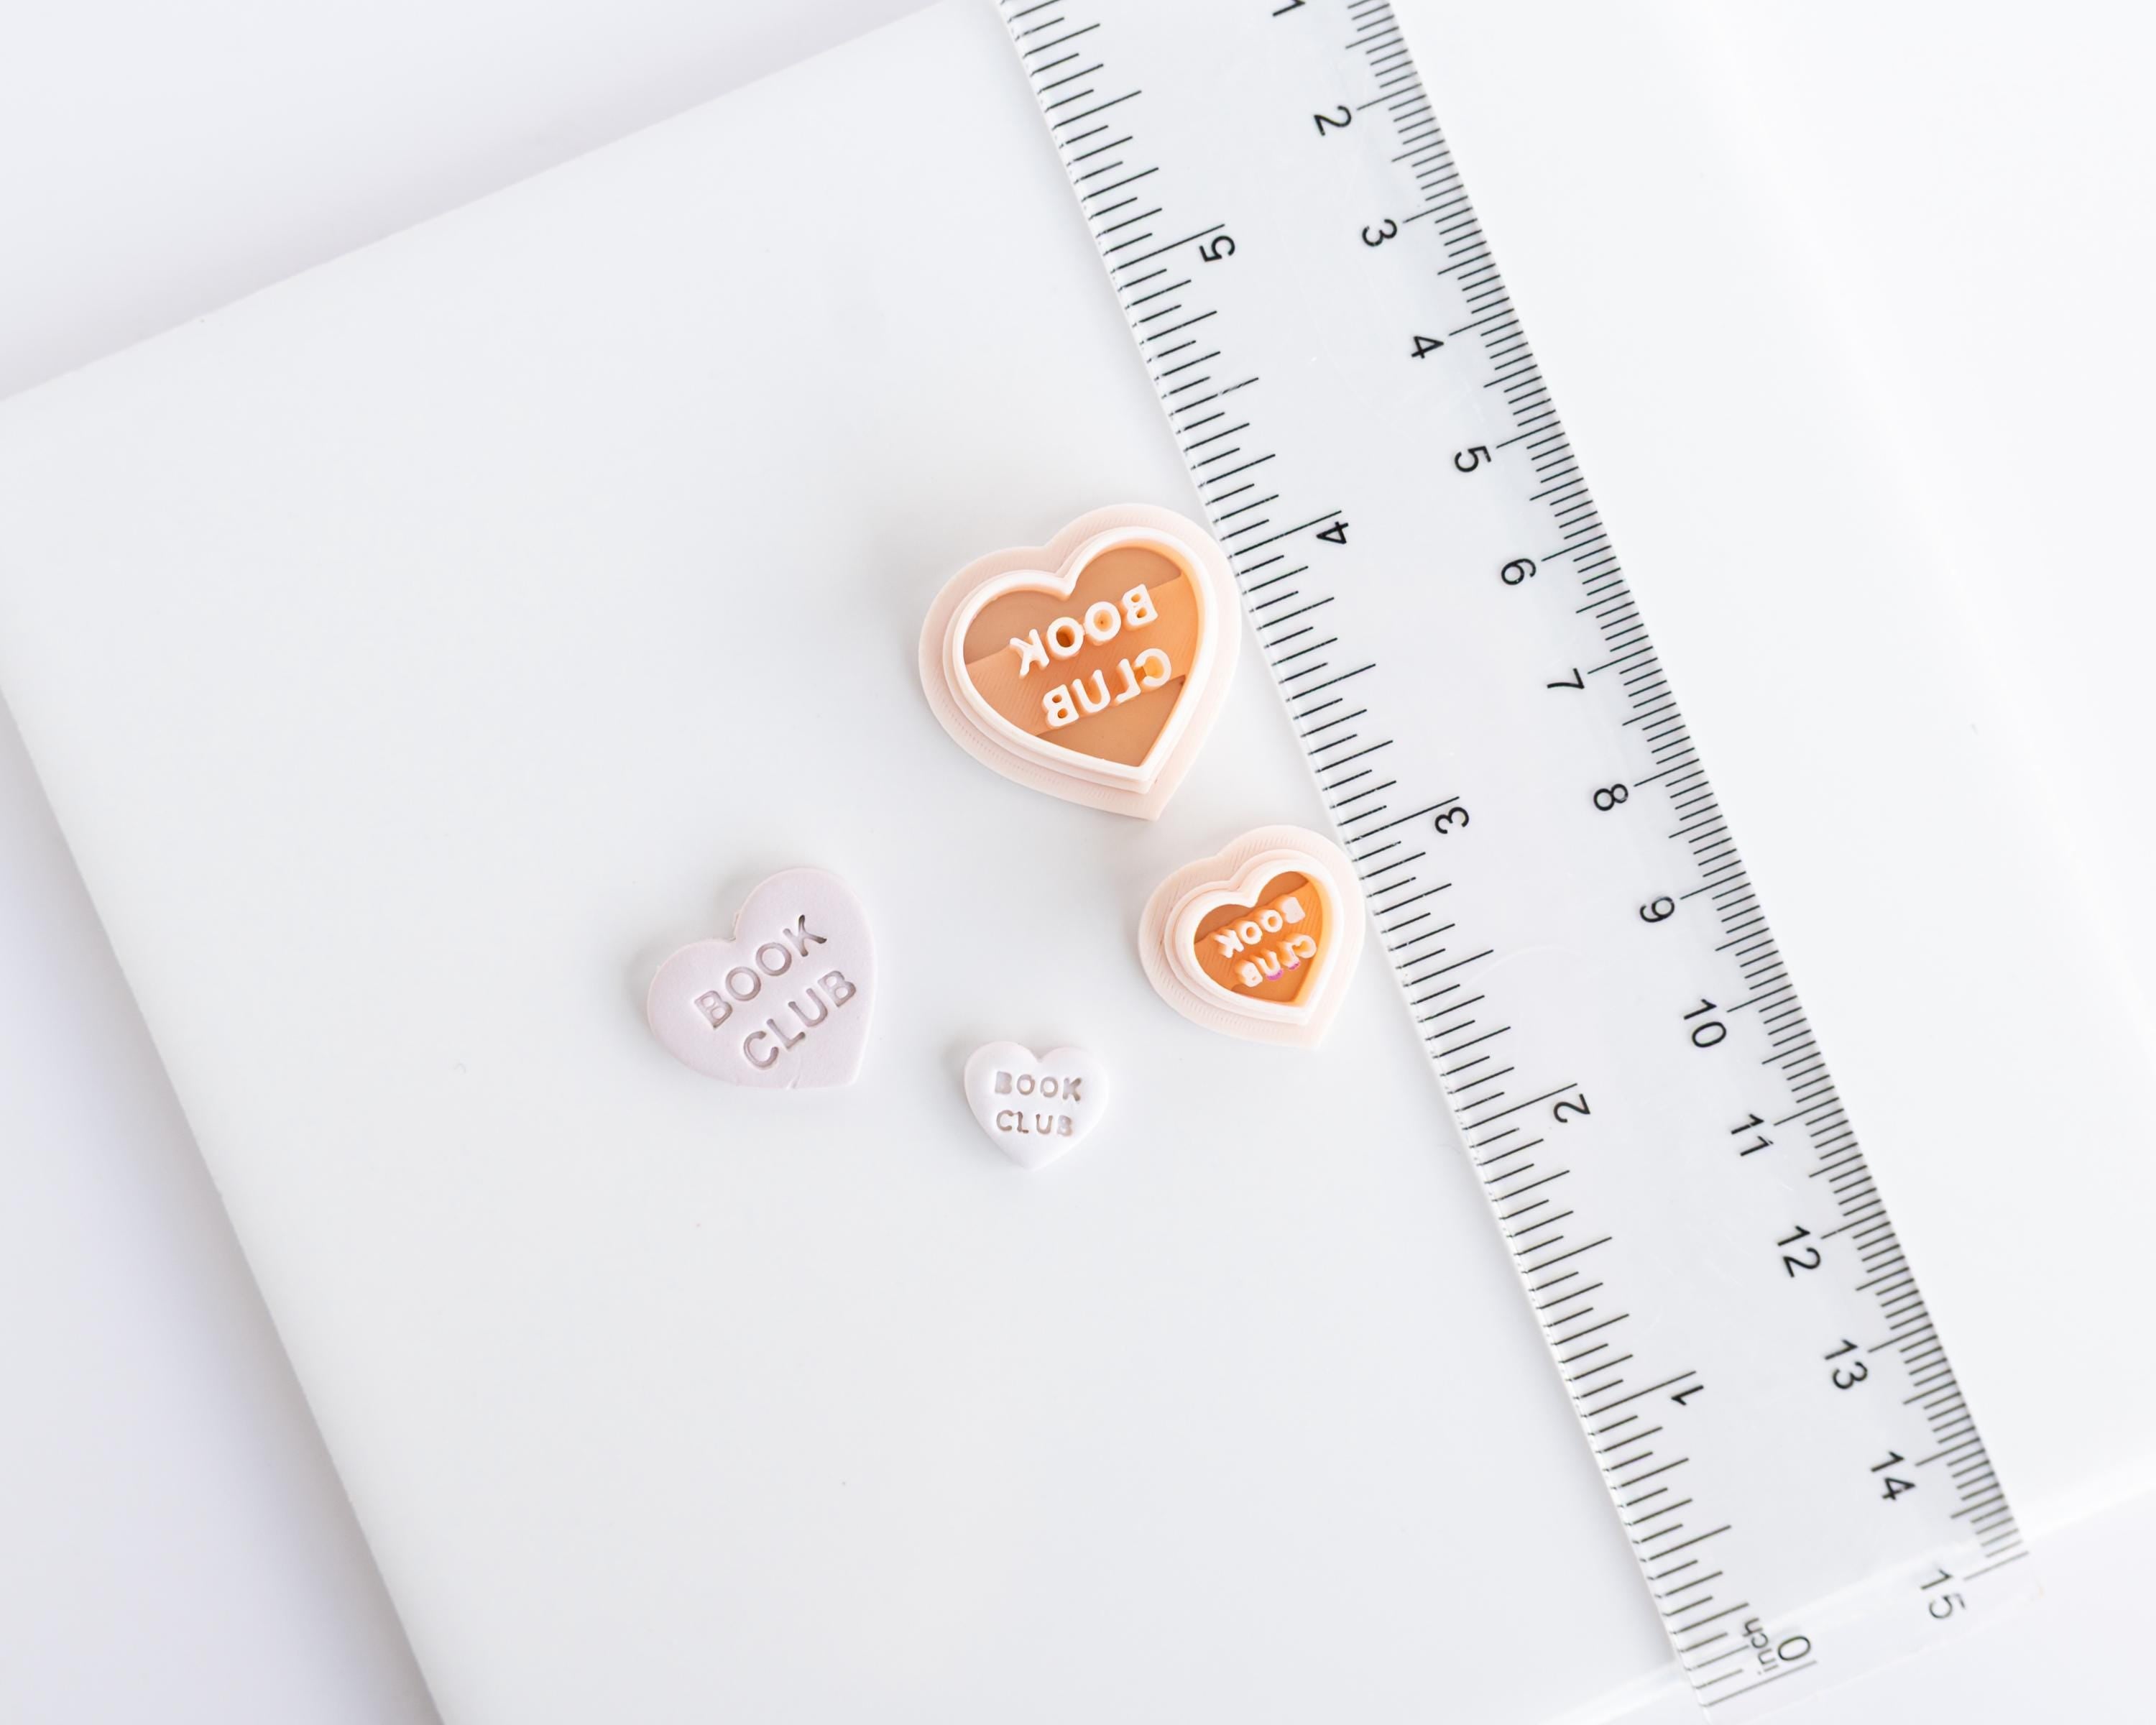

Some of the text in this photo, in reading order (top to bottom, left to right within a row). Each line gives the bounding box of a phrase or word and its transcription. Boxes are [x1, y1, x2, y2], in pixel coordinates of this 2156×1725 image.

[1313, 105, 1353, 137] 2
[1361, 218, 1398, 247] 3
[1411, 335, 1445, 359] 4
[1453, 446, 1492, 473] 5
[1501, 558, 1537, 586] 6
[1547, 668, 1585, 689] 7
[1593, 783, 1628, 811] 8
[1639, 896, 1675, 923] 9
[1683, 998, 1727, 1048] 10
[1731, 1113, 1774, 1157] 11
[1777, 1225, 1821, 1278] 12
[1824, 1339, 1869, 1390] 13
[1870, 1451, 1916, 1501] 14
[1920, 1568, 1966, 1619] 15
[694, 914, 827, 1029] BOOK
[1199, 235, 1811, 1662] 0 1 2 3 4 5
[743, 970, 856, 1069] CLUB
[994, 1071, 1082, 1101] BOOK
[996, 1110, 1072, 1136] CLUB
[1742, 1617, 1779, 1675] inch
